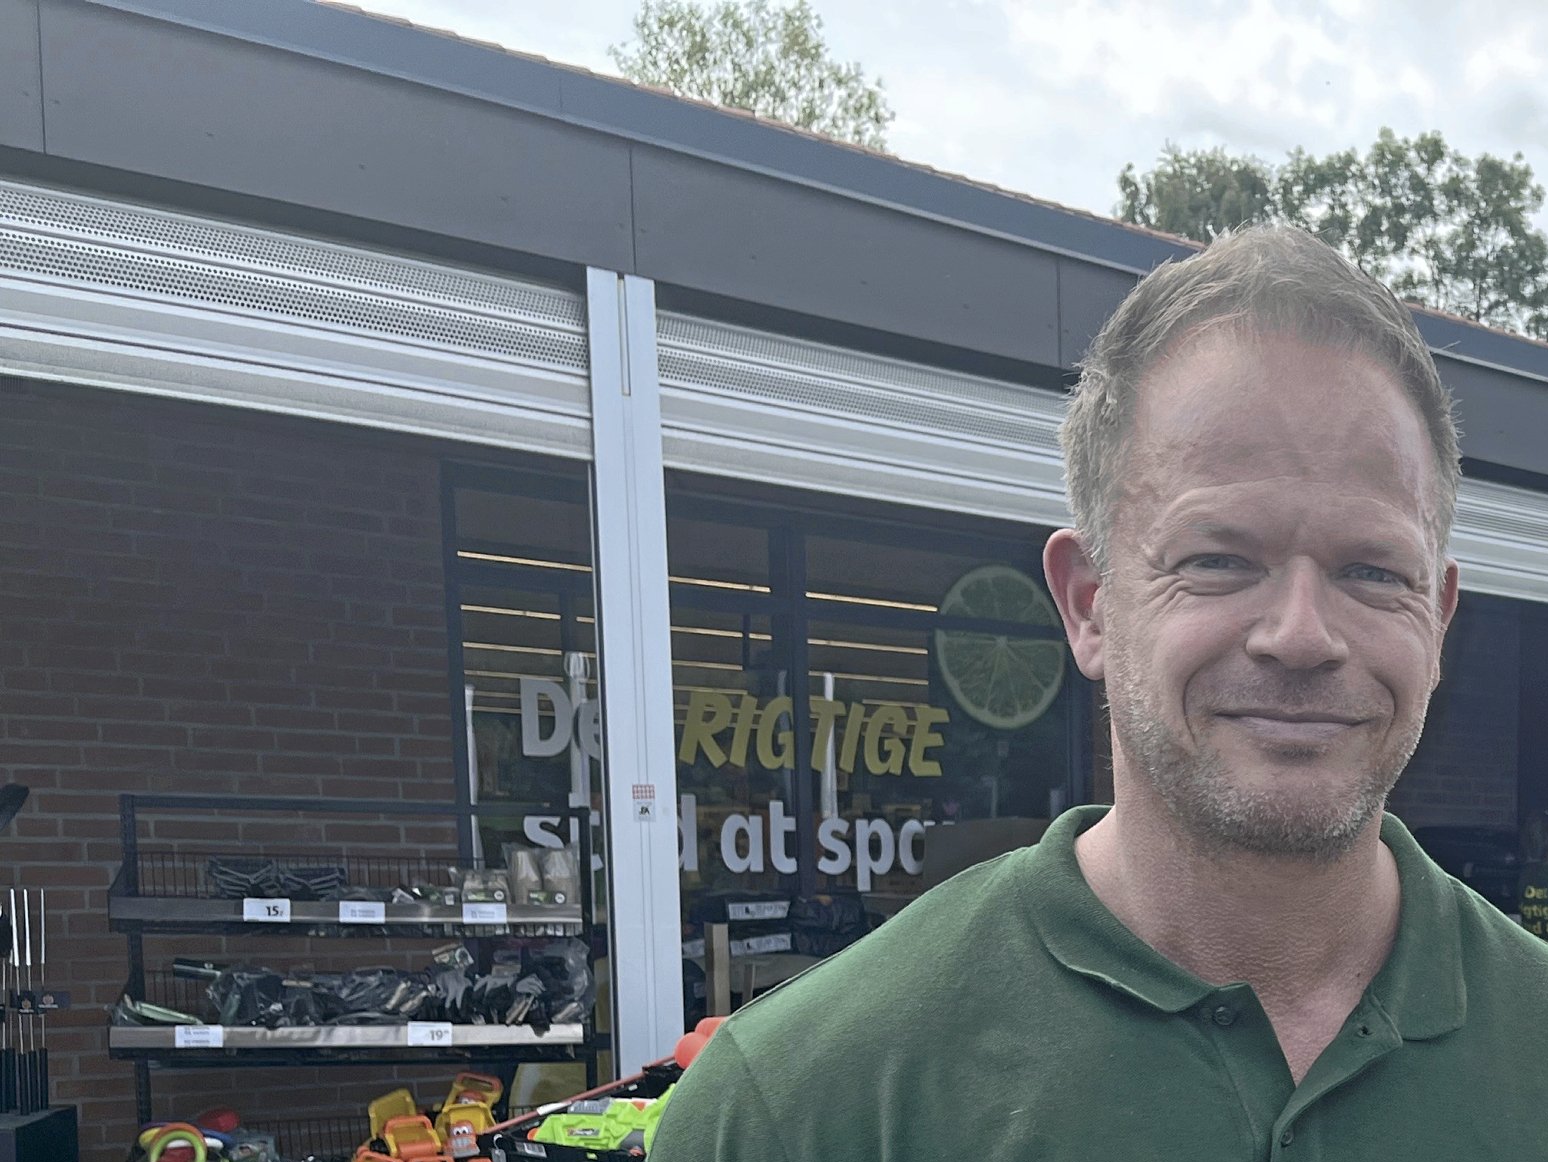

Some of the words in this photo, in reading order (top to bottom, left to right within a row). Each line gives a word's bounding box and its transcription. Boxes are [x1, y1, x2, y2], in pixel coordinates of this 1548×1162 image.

[520, 678, 600, 760] De
[679, 690, 950, 777] RIGTIGE
[720, 801, 797, 874] at
